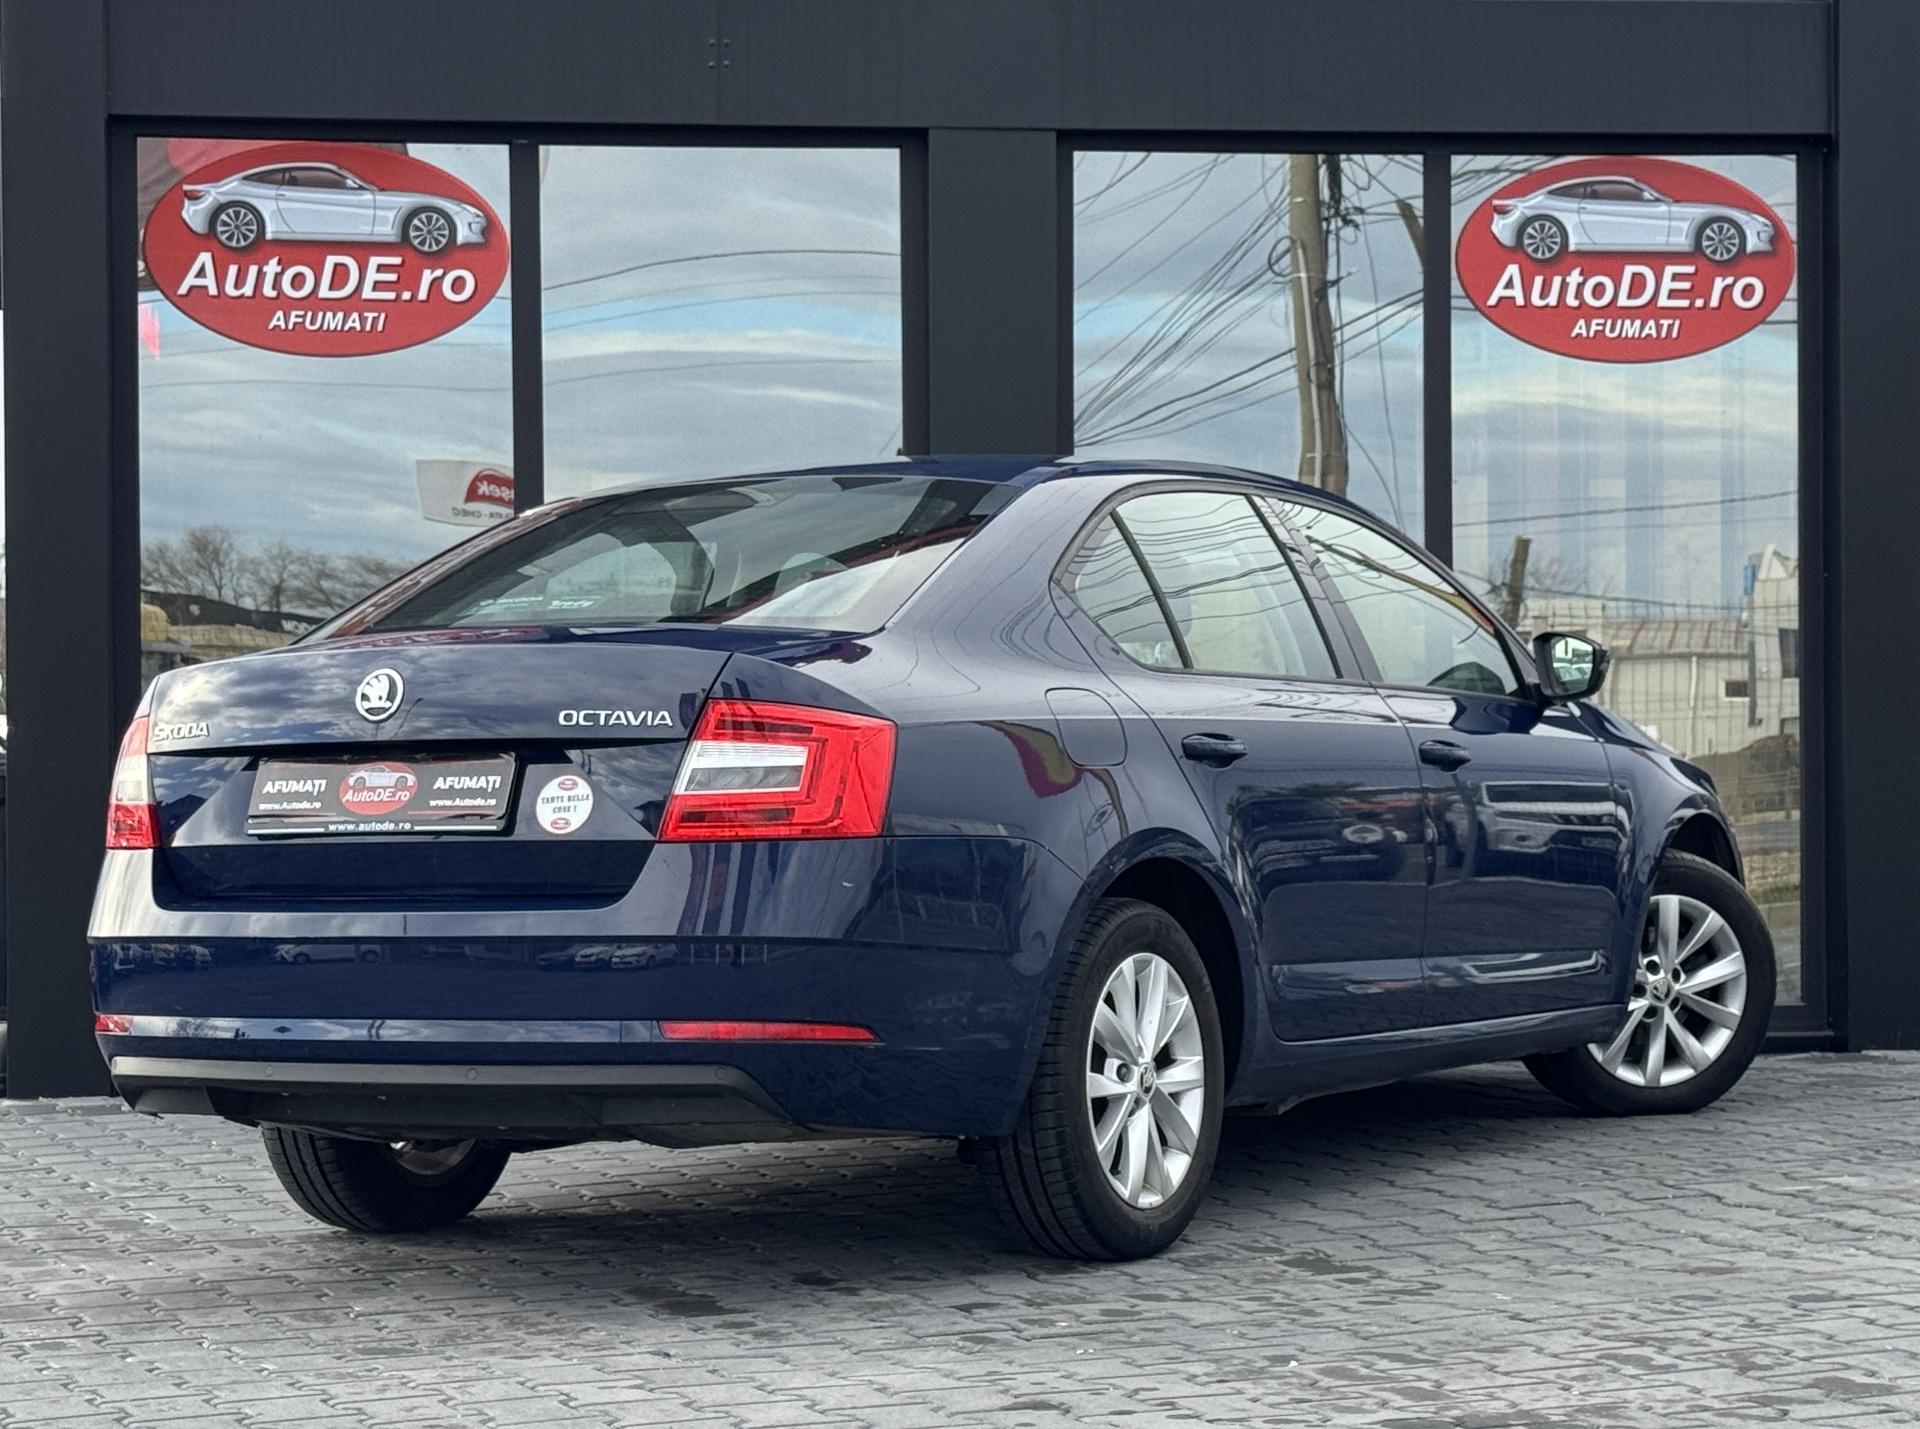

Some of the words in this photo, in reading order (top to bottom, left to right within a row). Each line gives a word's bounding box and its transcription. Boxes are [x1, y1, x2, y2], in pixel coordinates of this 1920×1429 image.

[177, 251, 477, 302] AutoDE.ro
[1486, 263, 1765, 310] AutoDE.ro
[268, 310, 387, 332] AFUMATI
[1570, 318, 1681, 340] AFUMATI
[558, 709, 674, 727] OCTAVIA
[342, 788, 410, 802] AutoDE.ro
[328, 821, 412, 832] www.autode.ro
